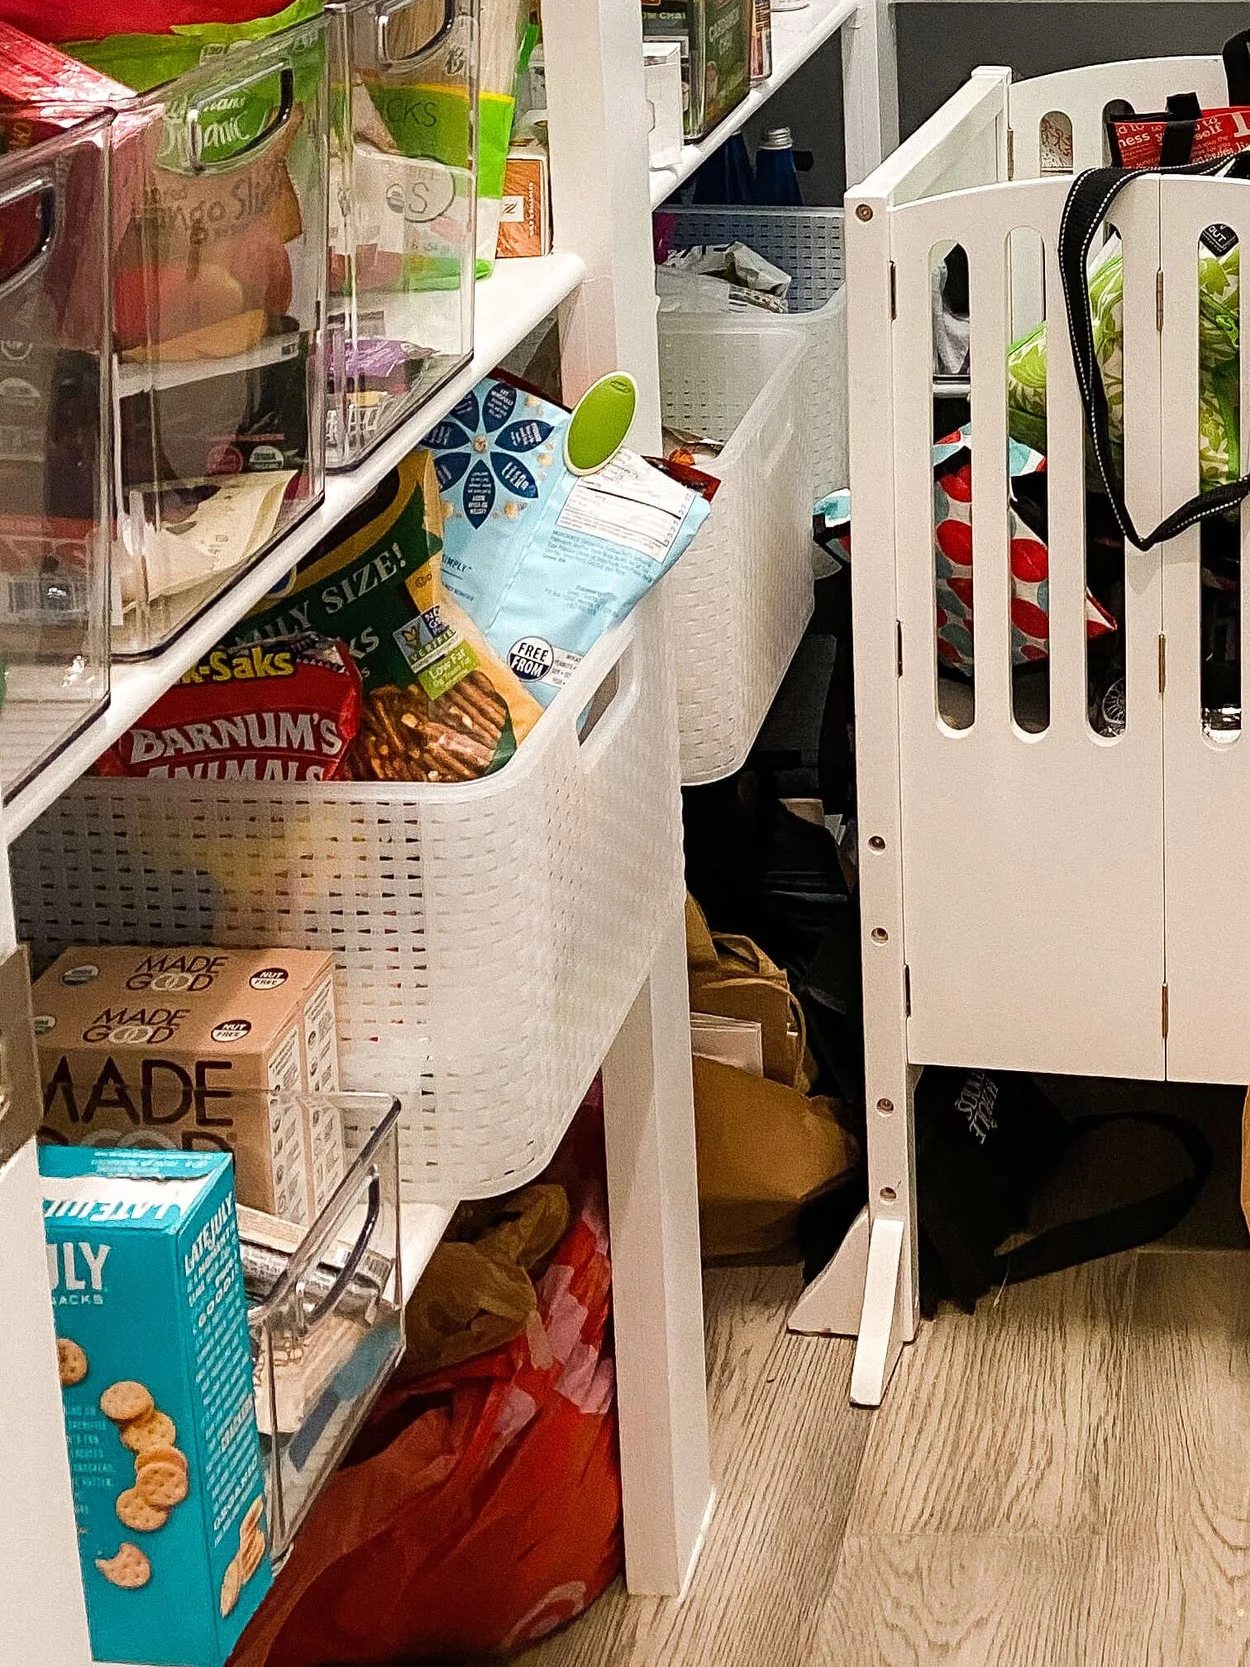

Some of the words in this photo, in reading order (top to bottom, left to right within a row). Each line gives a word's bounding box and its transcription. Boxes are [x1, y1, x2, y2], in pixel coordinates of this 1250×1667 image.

[321, 542, 408, 614] SIZE!
[517, 641, 549, 663] FREE
[511, 657, 544, 678] FROM
[129, 710, 343, 765] BARNUM'S
[134, 955, 228, 974] MADE
[125, 972, 214, 992] GOOD
[259, 970, 284, 980] NUT
[92, 1007, 191, 1025] MADE
[83, 1024, 176, 1044] GOOD
[222, 1022, 247, 1031] NUT
